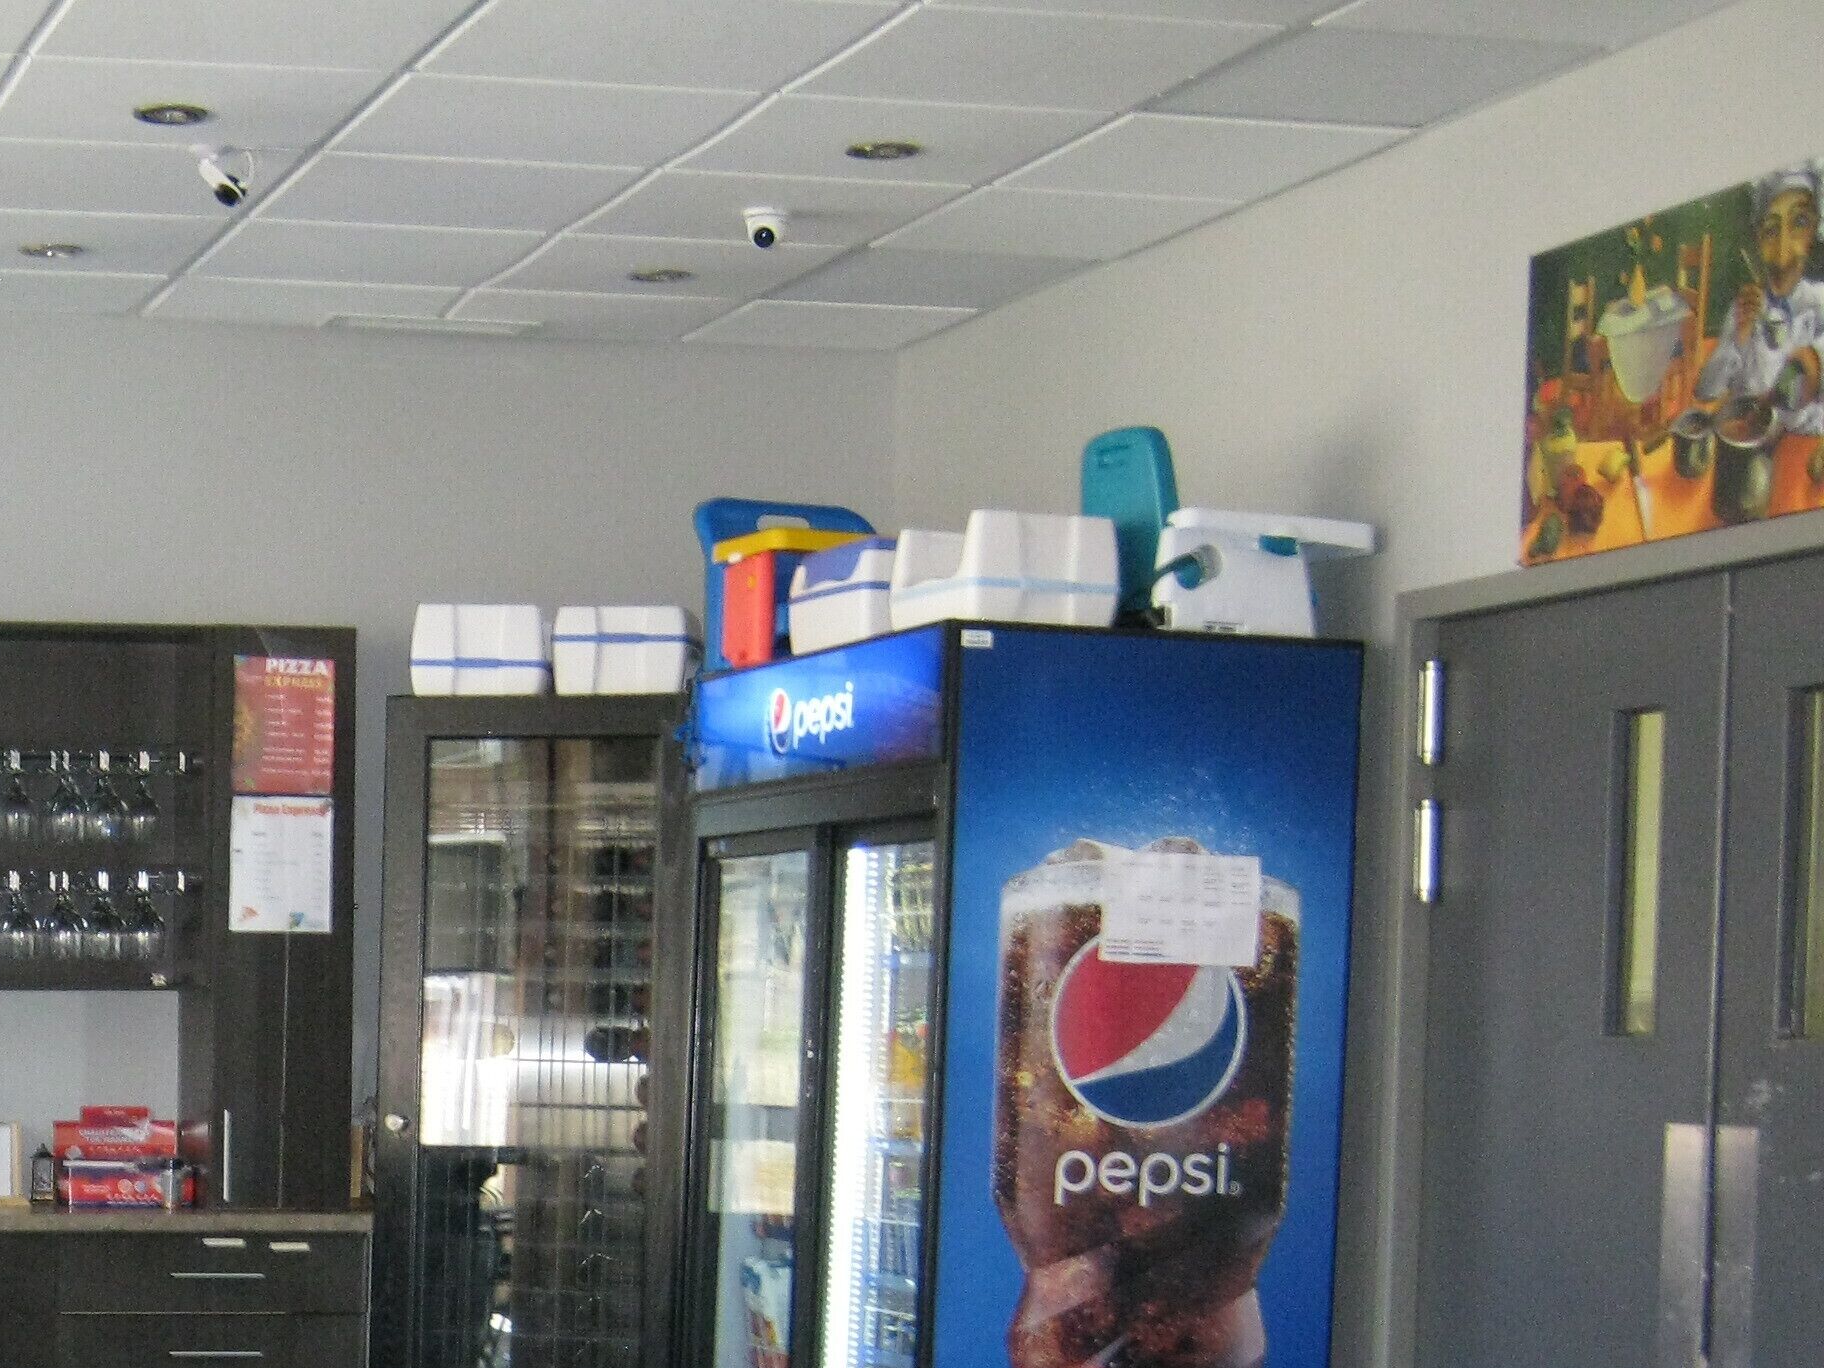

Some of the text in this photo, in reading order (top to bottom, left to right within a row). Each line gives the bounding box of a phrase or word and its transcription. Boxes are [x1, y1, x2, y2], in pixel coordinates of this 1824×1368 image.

[265, 658, 328, 675] PIZZA
[793, 680, 854, 750] pepsi
[1053, 1142, 1231, 1207] pepsi
